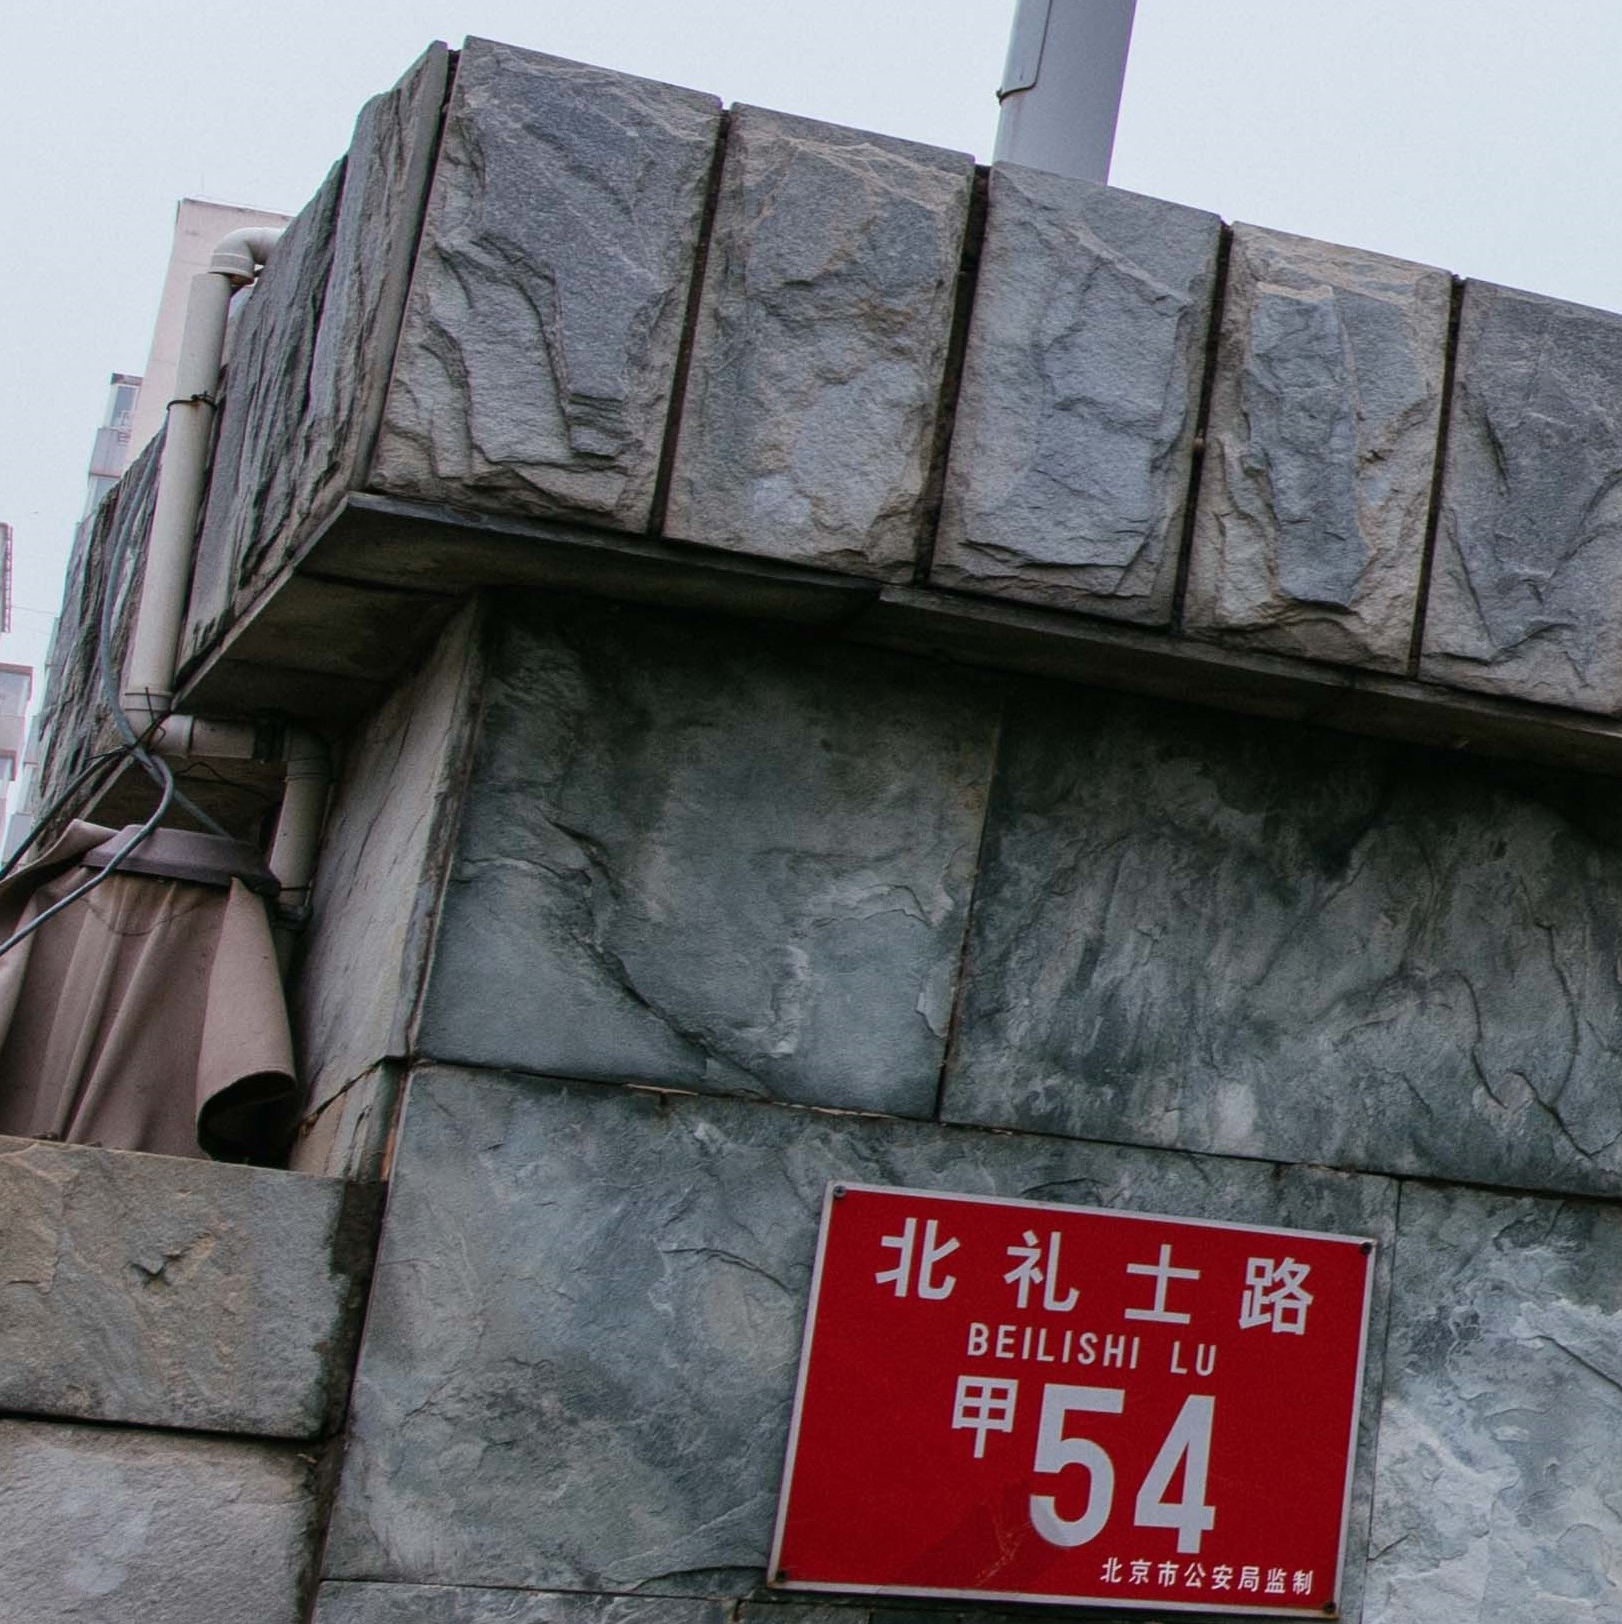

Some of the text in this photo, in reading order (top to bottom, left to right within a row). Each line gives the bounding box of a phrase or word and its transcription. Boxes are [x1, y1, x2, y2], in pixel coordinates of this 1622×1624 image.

[875, 1217, 1314, 1335] 北礼士路
[966, 1321, 1217, 1377] BEILISHI LU
[1100, 1556, 1314, 1597] 北京市公安局监制
